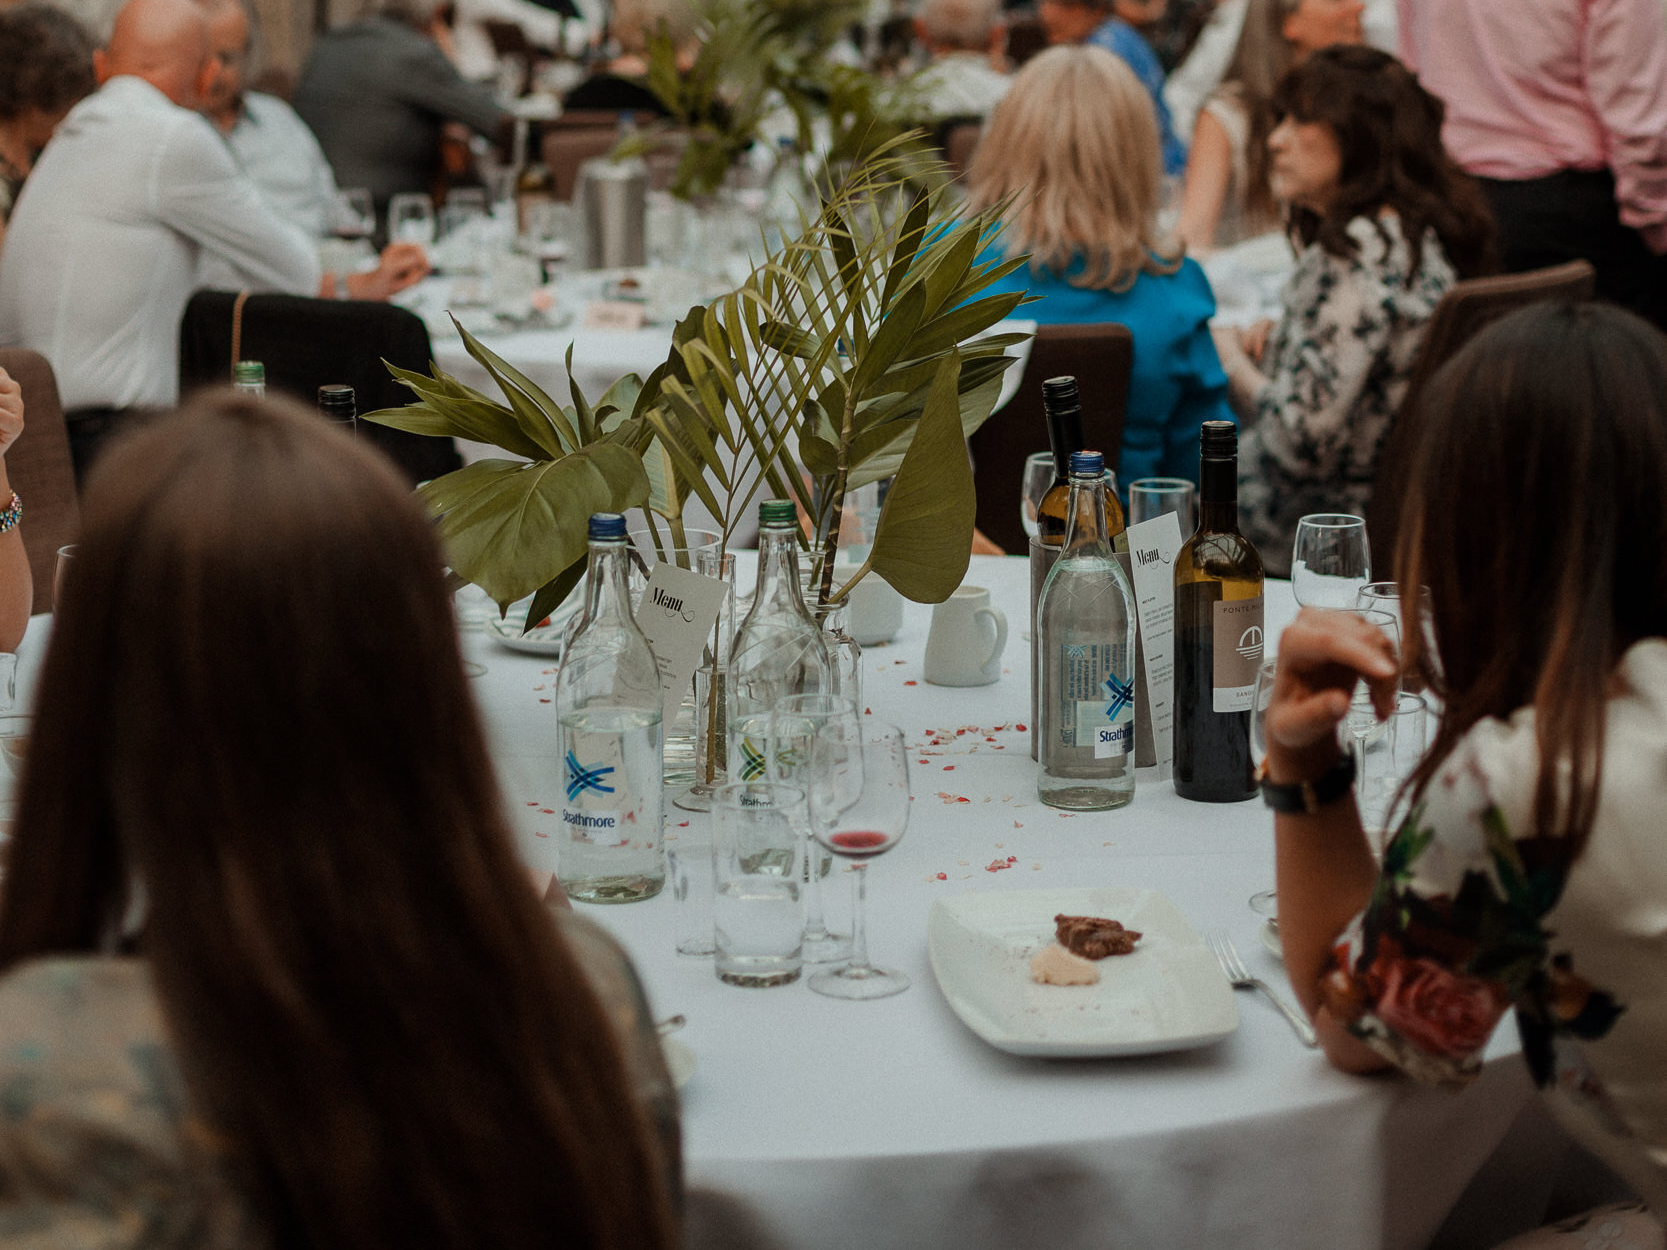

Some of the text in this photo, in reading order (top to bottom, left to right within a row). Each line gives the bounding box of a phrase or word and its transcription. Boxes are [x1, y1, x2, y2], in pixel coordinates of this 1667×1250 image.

[1136, 548, 1170, 569] Menu
[650, 587, 695, 622] Menu
[1223, 605, 1249, 614] PONTE
[563, 808, 615, 828] Strathmore
